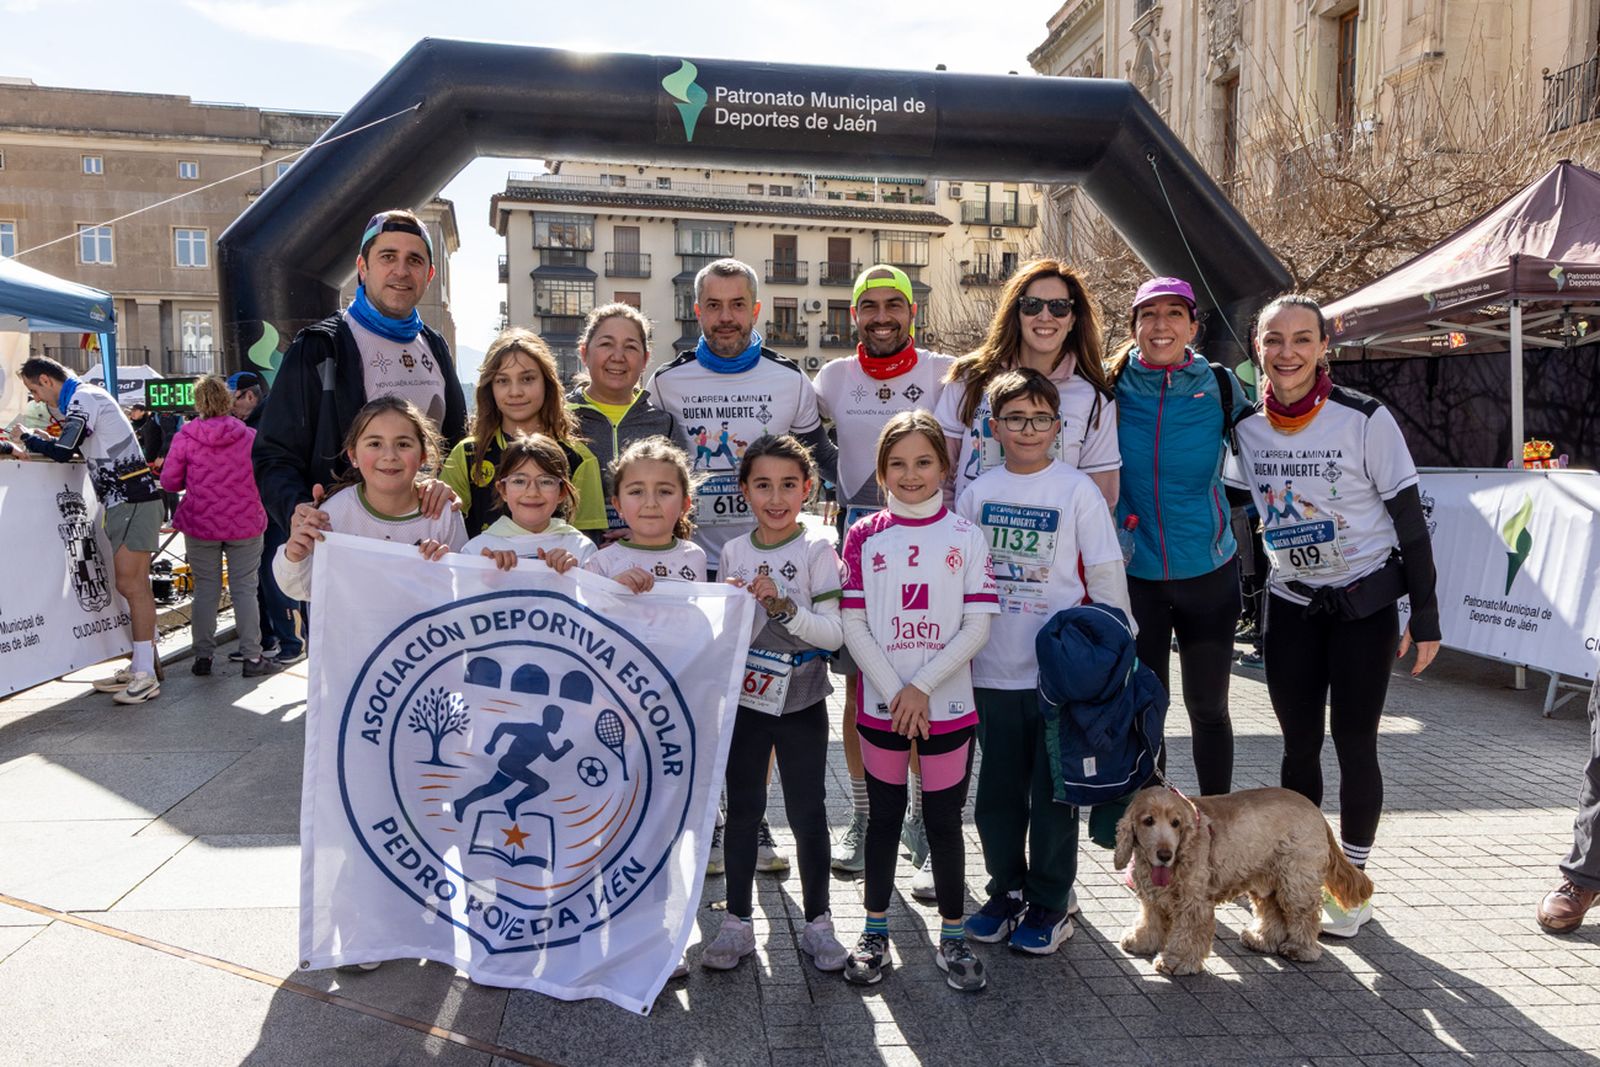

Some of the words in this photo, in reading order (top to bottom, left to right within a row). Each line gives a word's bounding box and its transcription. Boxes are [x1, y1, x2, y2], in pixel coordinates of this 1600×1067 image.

[715, 86, 804, 107] Patronato
[811, 92, 897, 115] Municipal
[903, 97, 926, 113] de
[715, 108, 800, 129] Deportes
[805, 112, 828, 129] de
[833, 114, 877, 132] Jaén
[1567, 272, 1600, 280] Patronato
[1458, 284, 1482, 295] Municipal
[682, 395, 690, 404] VI
[691, 395, 728, 404] CARRERA
[731, 394, 772, 402] CAMINATA
[683, 407, 713, 419] BUENA
[716, 406, 754, 419] MUERTE
[1260, 450, 1293, 459] CARRERA
[1296, 449, 1343, 459] CAMINATA
[1254, 462, 1279, 476] BUENA
[1280, 463, 1320, 477] MUERTE
[714, 495, 748, 514] 618
[1009, 516, 1037, 528] MUERTE
[992, 527, 1040, 553] 1132
[908, 545, 920, 567] 2
[1289, 545, 1320, 567] 619
[1398, 602, 1410, 614] DE
[1463, 595, 1498, 610] Patronato
[1498, 601, 1540, 618] Municipal
[1541, 608, 1552, 620] de
[35, 614, 45, 626] de
[73, 620, 102, 639] CIUDAD
[102, 618, 114, 631] DE
[114, 611, 132, 629] JAÉN
[891, 615, 940, 641] Jaén
[1504, 616, 1516, 628] de
[12, 636, 22, 650] de
[23, 633, 41, 646] Jaén
[361, 623, 466, 746] ASOCIACIÓN
[472, 608, 618, 671] DEPORTIVA
[617, 660, 683, 777] ESCOLAR
[743, 671, 775, 696] 67
[372, 816, 458, 902] PEDRO
[464, 894, 580, 941] POVEDA
